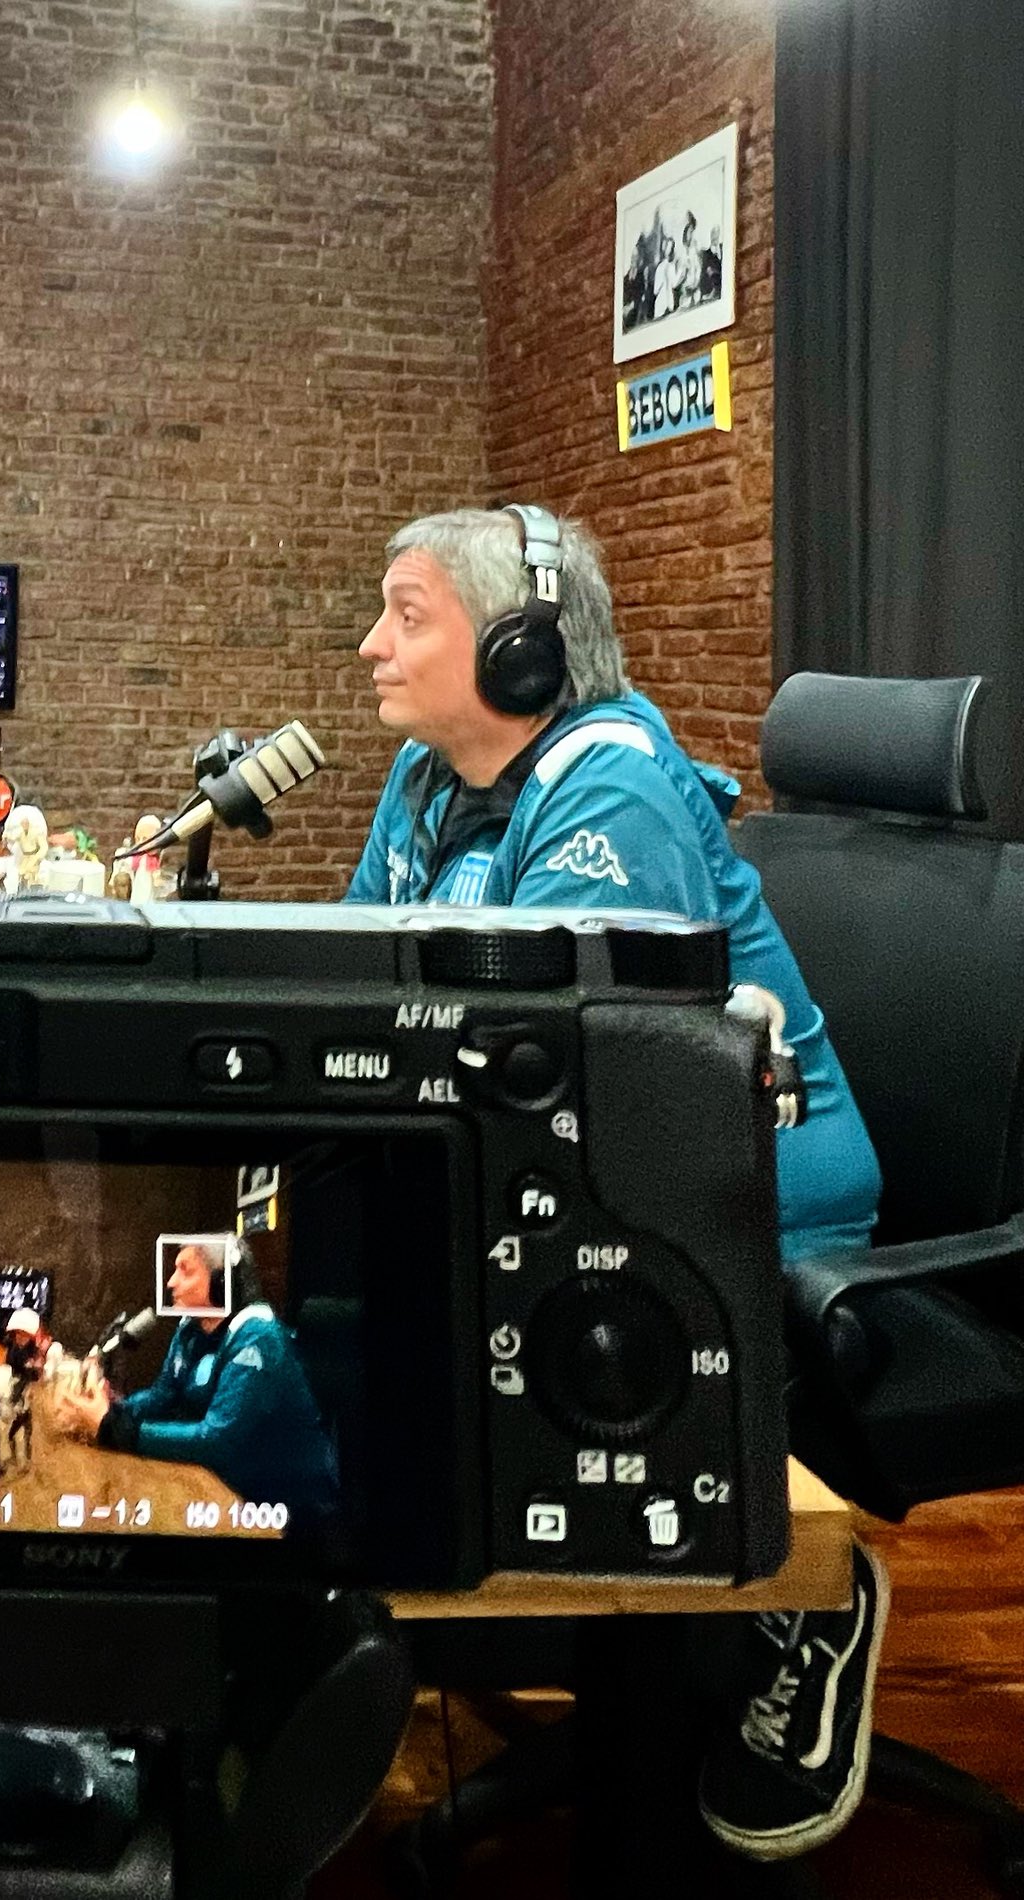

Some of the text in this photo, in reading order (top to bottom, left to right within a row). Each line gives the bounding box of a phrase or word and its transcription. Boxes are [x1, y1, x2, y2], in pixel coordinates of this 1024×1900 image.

[395, 1003, 465, 1029] AF/MF
[325, 1053, 391, 1079] MENU
[418, 1077, 461, 1102] AEL
[521, 1189, 556, 1216] Fn
[577, 1244, 629, 1270] DISP
[691, 1348, 729, 1375] ISO
[228, 1500, 288, 1529] 1000
